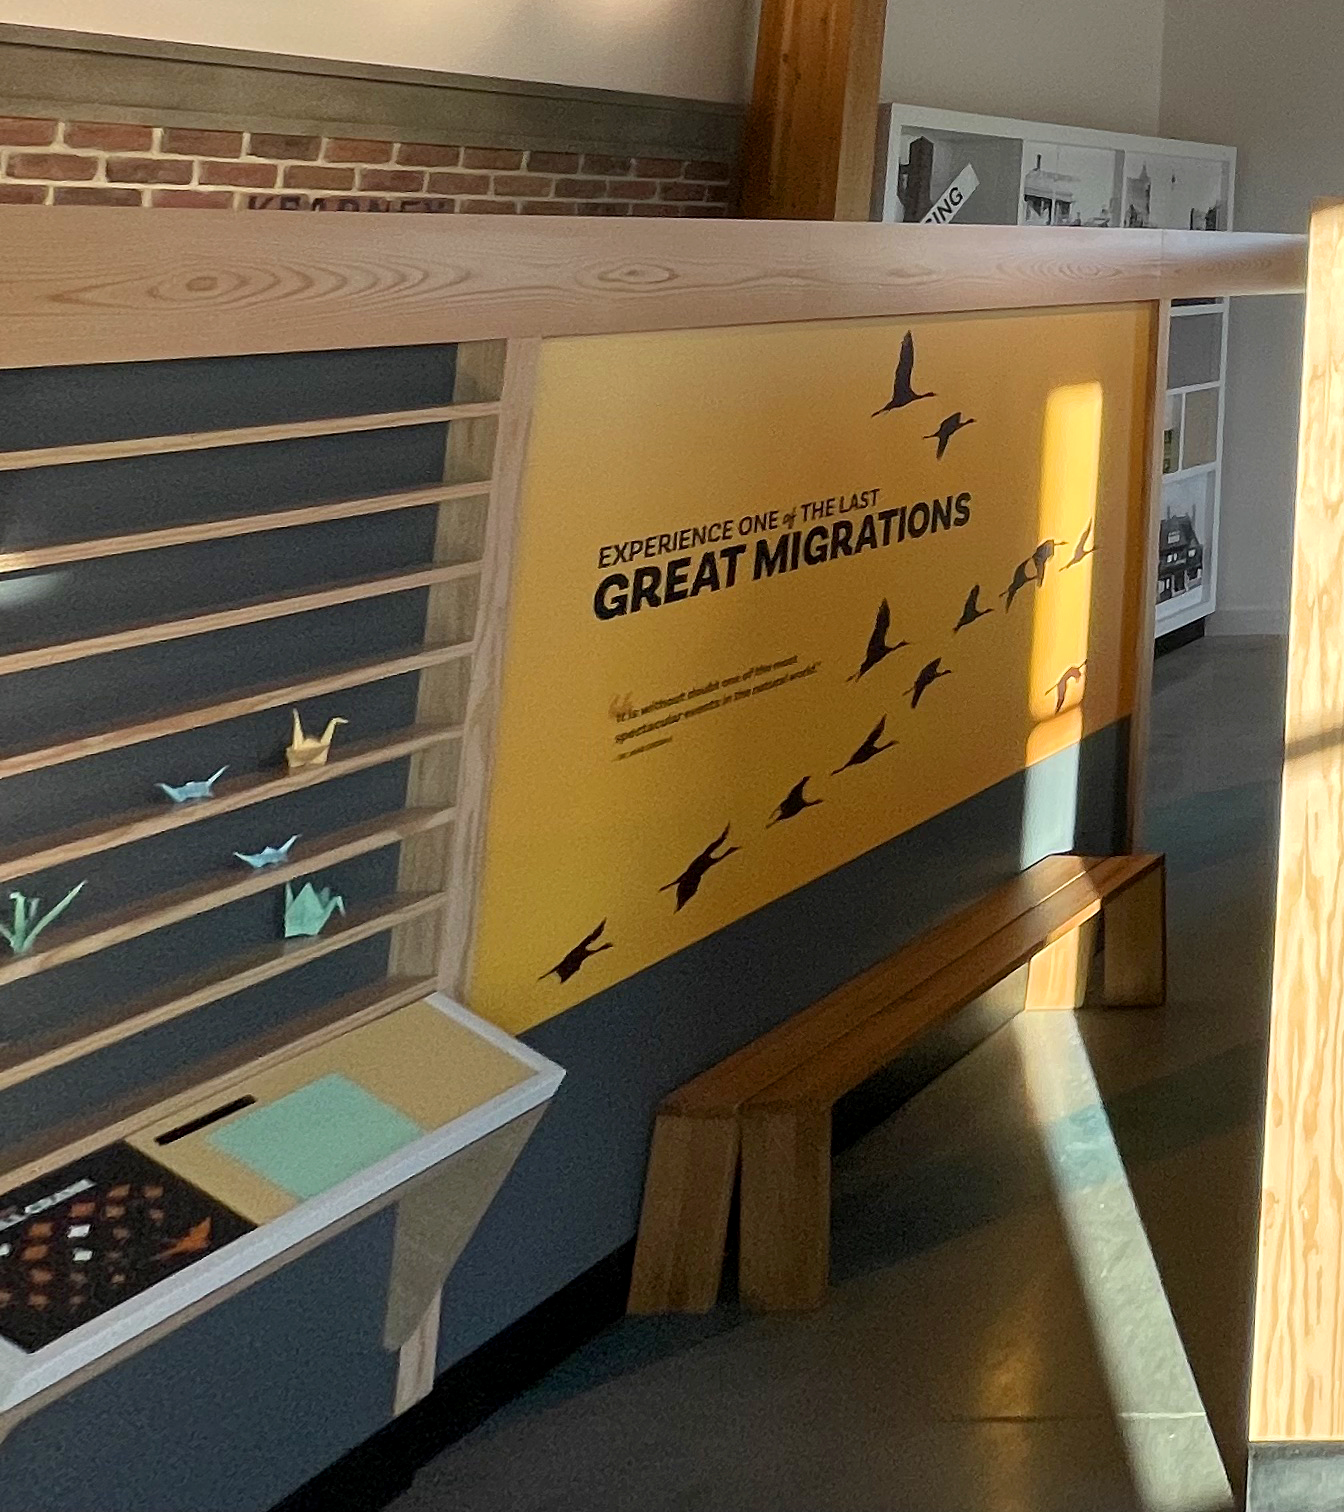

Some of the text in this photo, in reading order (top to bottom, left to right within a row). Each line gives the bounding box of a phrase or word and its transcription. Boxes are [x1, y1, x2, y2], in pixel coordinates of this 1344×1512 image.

[925, 186, 964, 224] ING
[593, 491, 972, 622] GREAT MIGRATIONS
[597, 488, 881, 570] EXPERIENCE ONE of THE LAST
